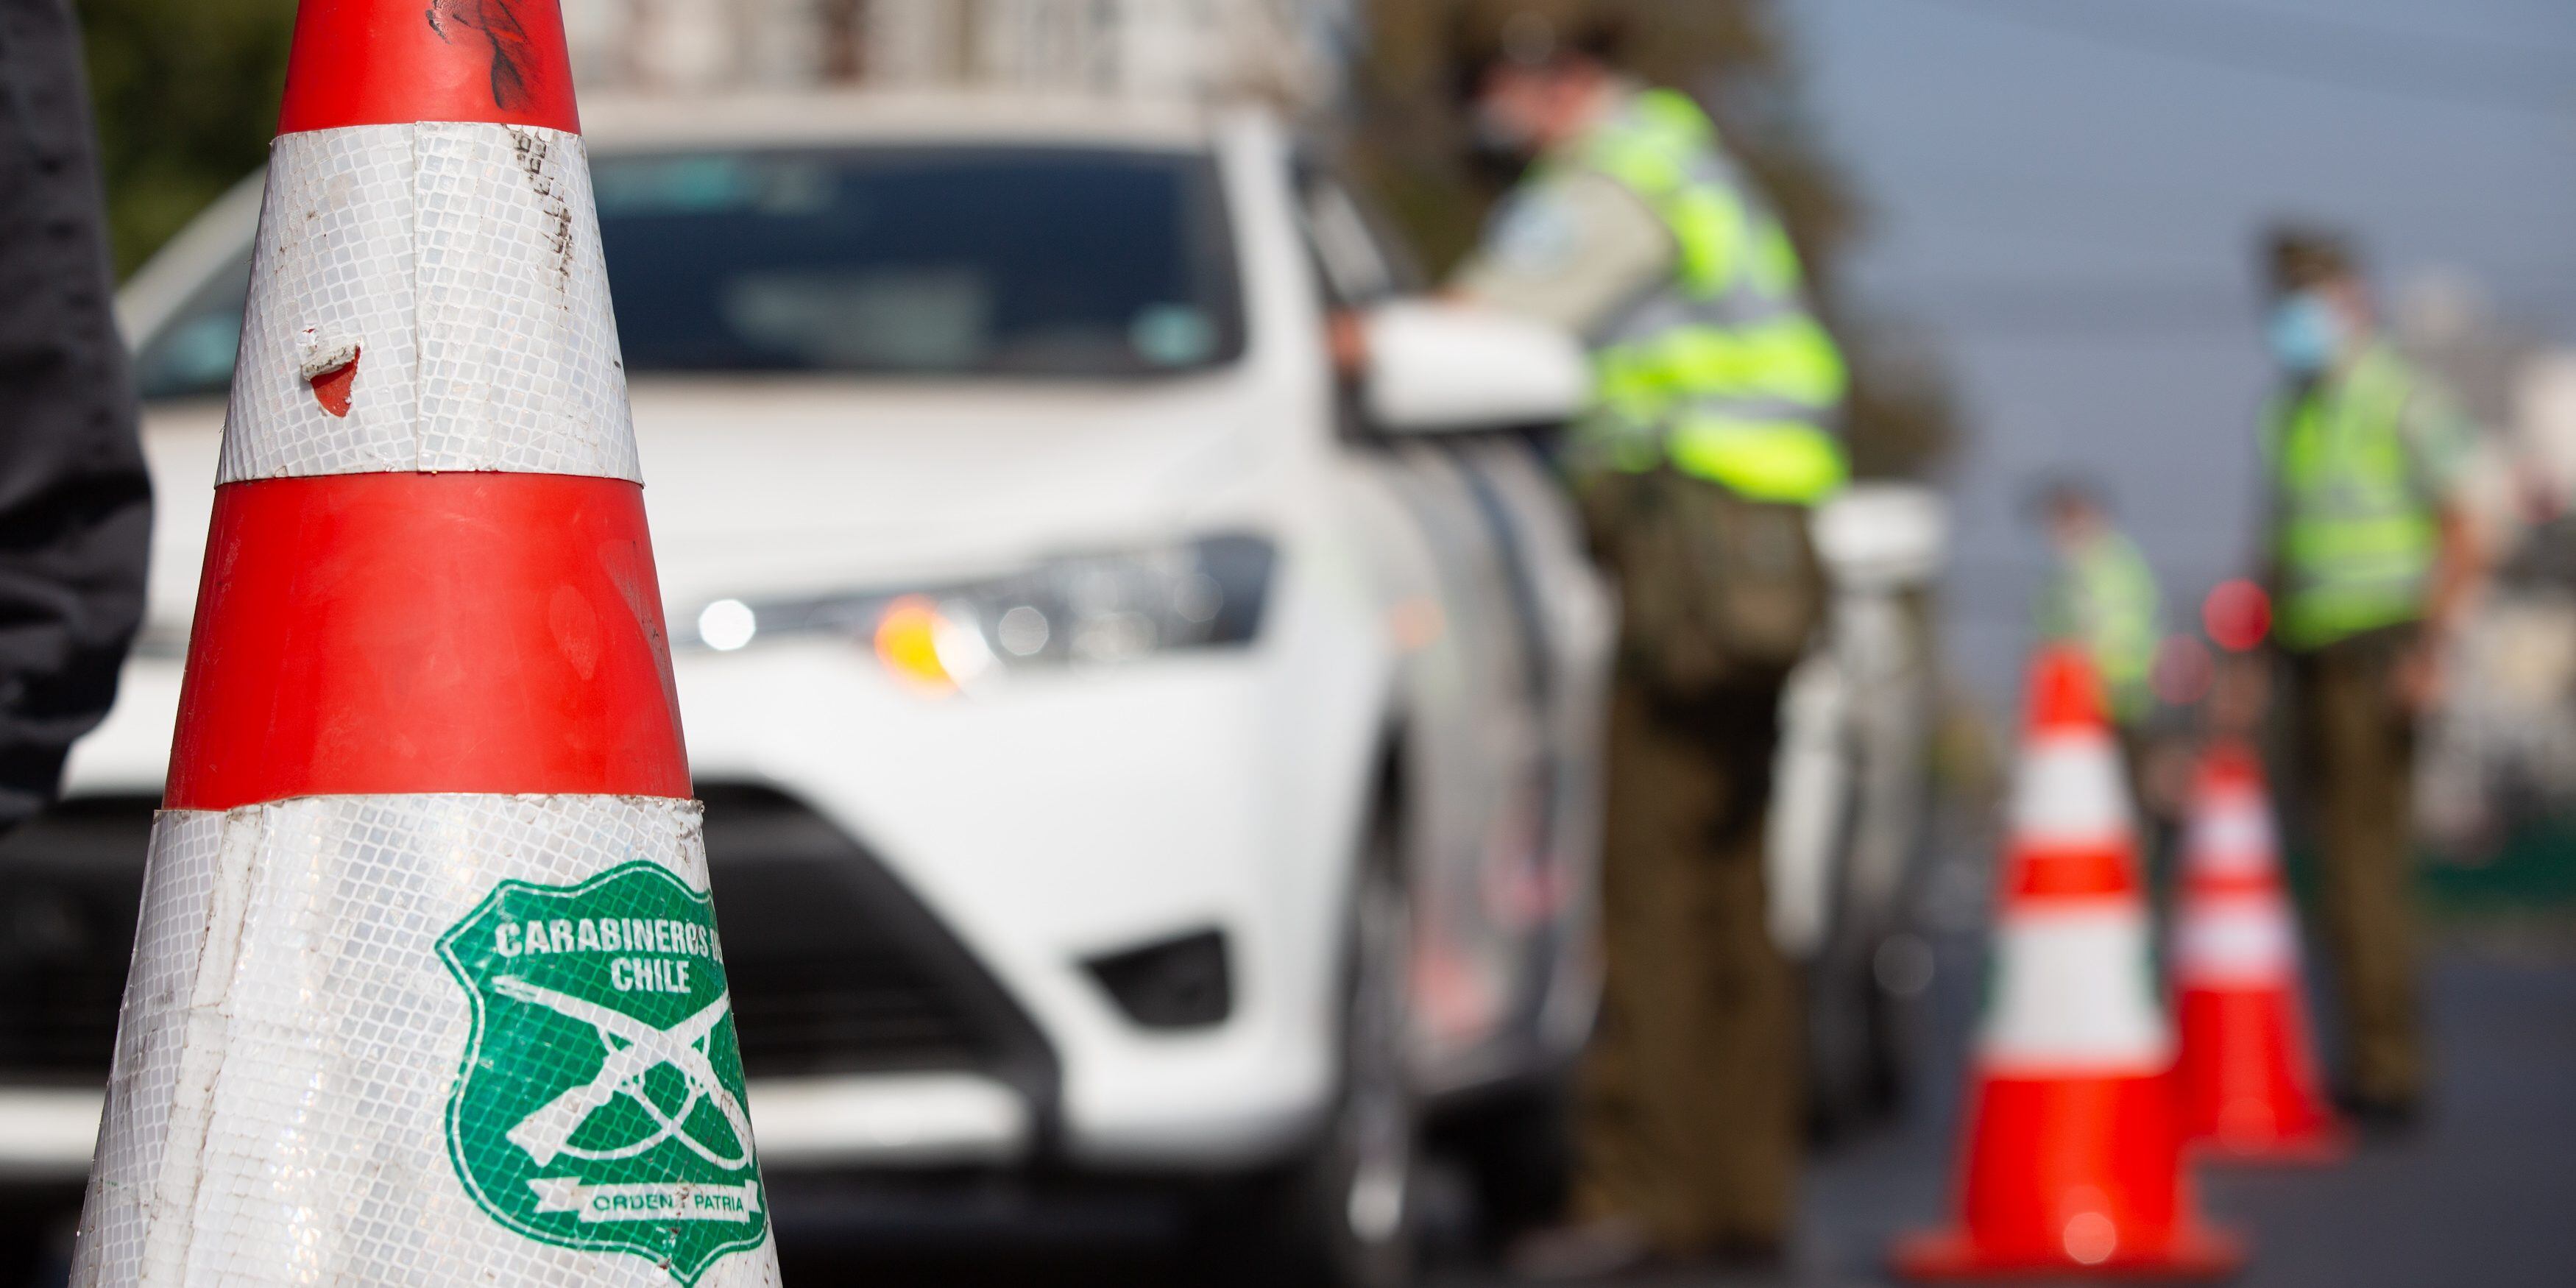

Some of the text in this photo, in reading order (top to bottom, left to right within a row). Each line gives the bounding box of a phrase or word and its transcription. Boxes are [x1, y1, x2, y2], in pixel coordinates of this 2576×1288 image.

[495, 918, 709, 958] CARABINEROS
[611, 958, 691, 993] CHILE
[593, 1194, 673, 1211] ORDEN
[694, 1195, 744, 1212] PATRIA
